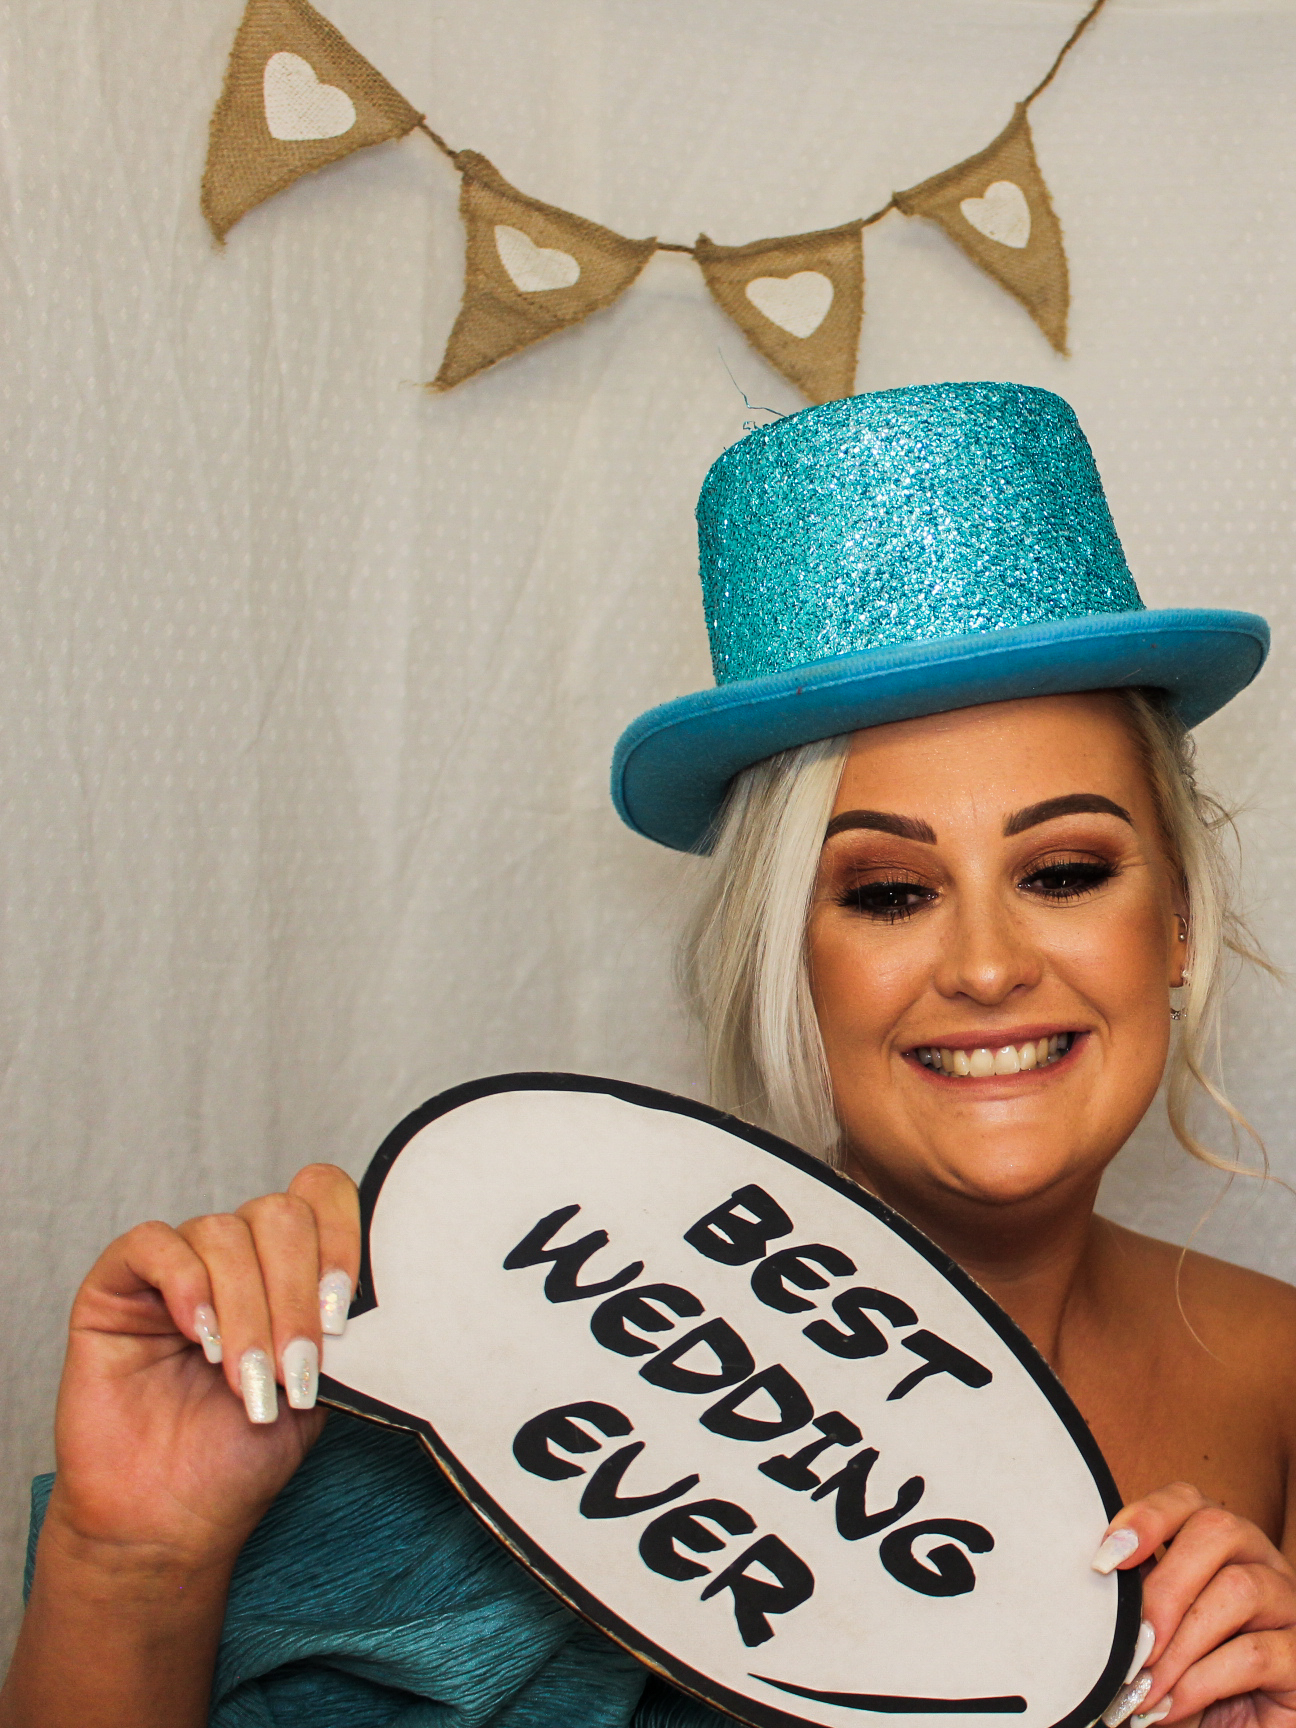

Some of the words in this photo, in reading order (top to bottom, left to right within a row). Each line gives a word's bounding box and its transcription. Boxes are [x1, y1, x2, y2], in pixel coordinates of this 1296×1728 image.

[503, 1204, 995, 1597] WEDDING
[683, 1184, 993, 1401] BEST
[512, 1401, 815, 1648] EVER
